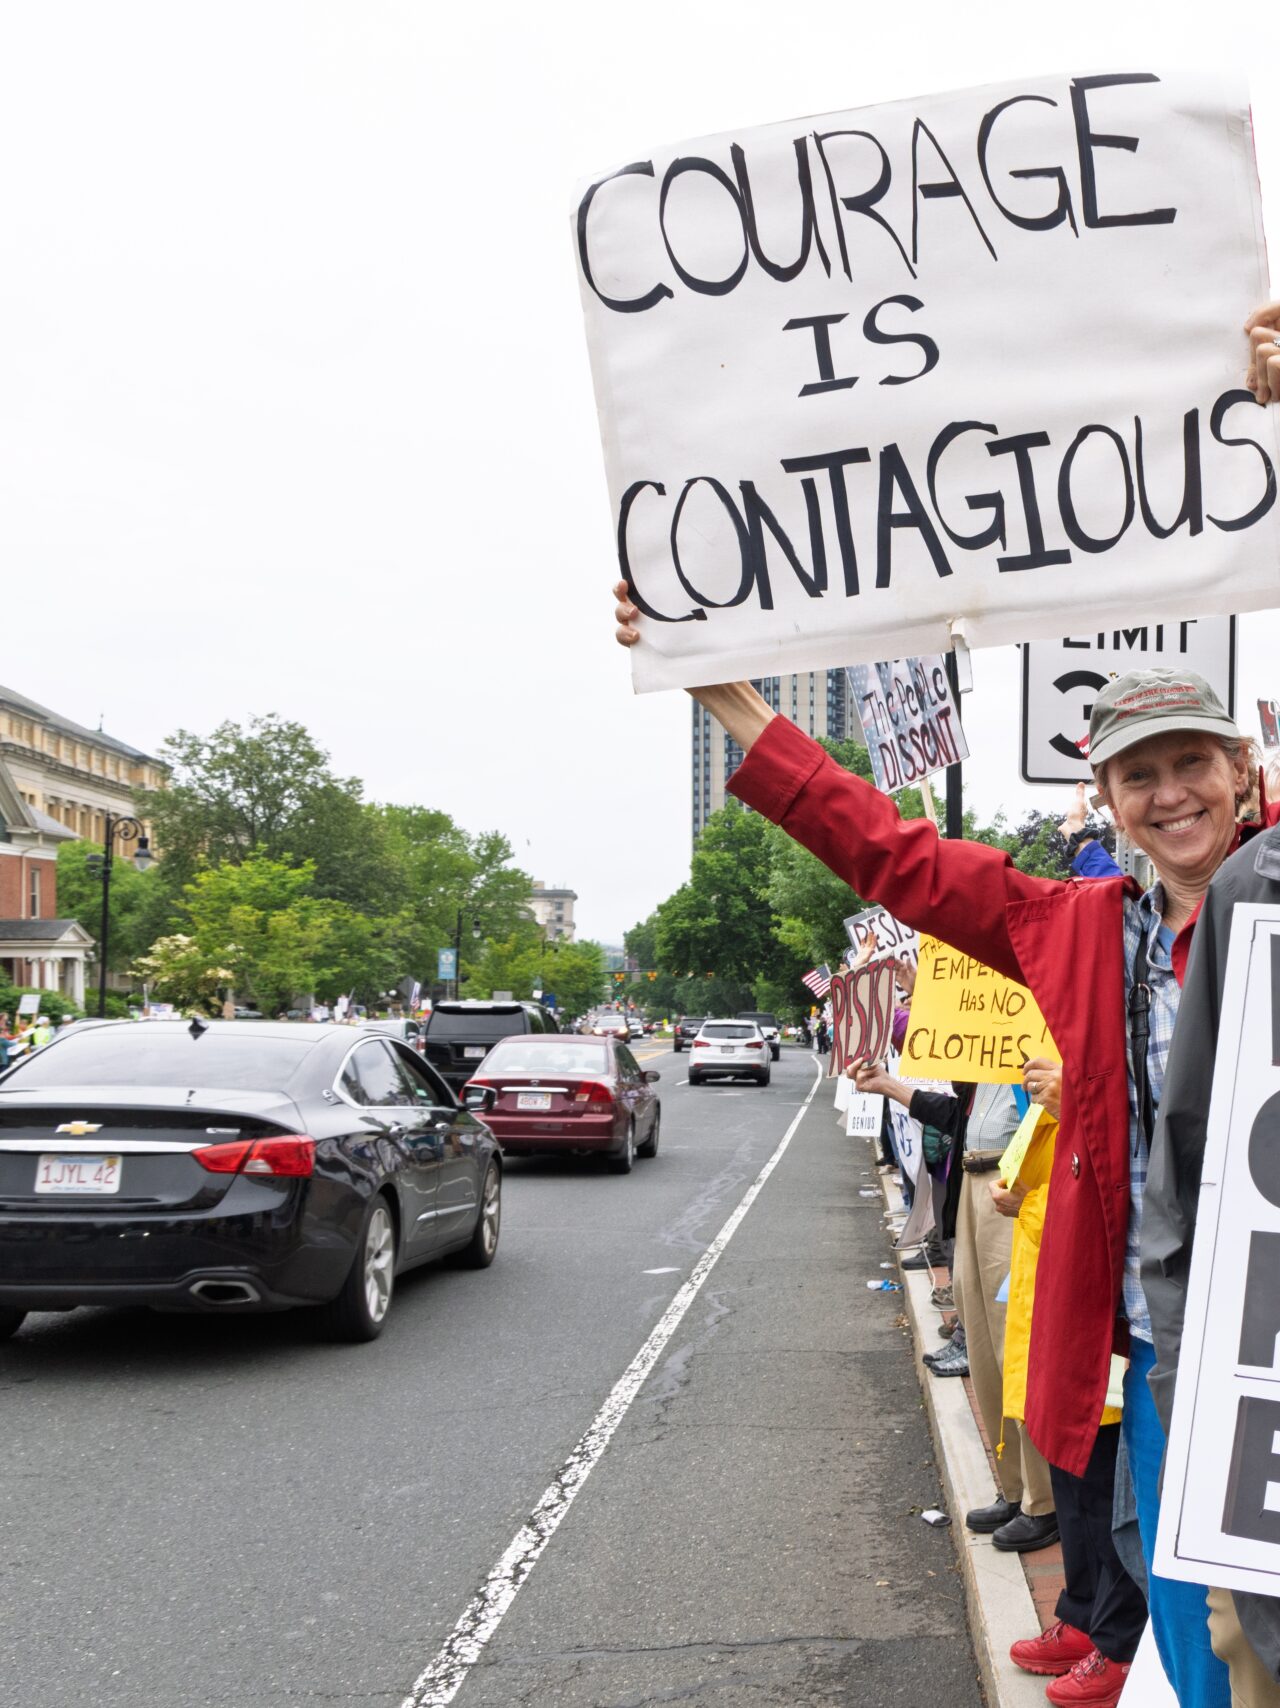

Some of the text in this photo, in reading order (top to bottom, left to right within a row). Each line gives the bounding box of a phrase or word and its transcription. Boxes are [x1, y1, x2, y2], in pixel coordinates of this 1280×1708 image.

[577, 72, 1177, 314] COURAGE
[783, 293, 940, 398] IS
[618, 388, 1277, 623] CONTAGIOUS
[862, 690, 899, 736] The
[829, 957, 895, 1075] RESIST
[991, 987, 1026, 1017] NO
[852, 1116, 875, 1130] GENIUS
[41, 1164, 116, 1184] 1JYL 42
